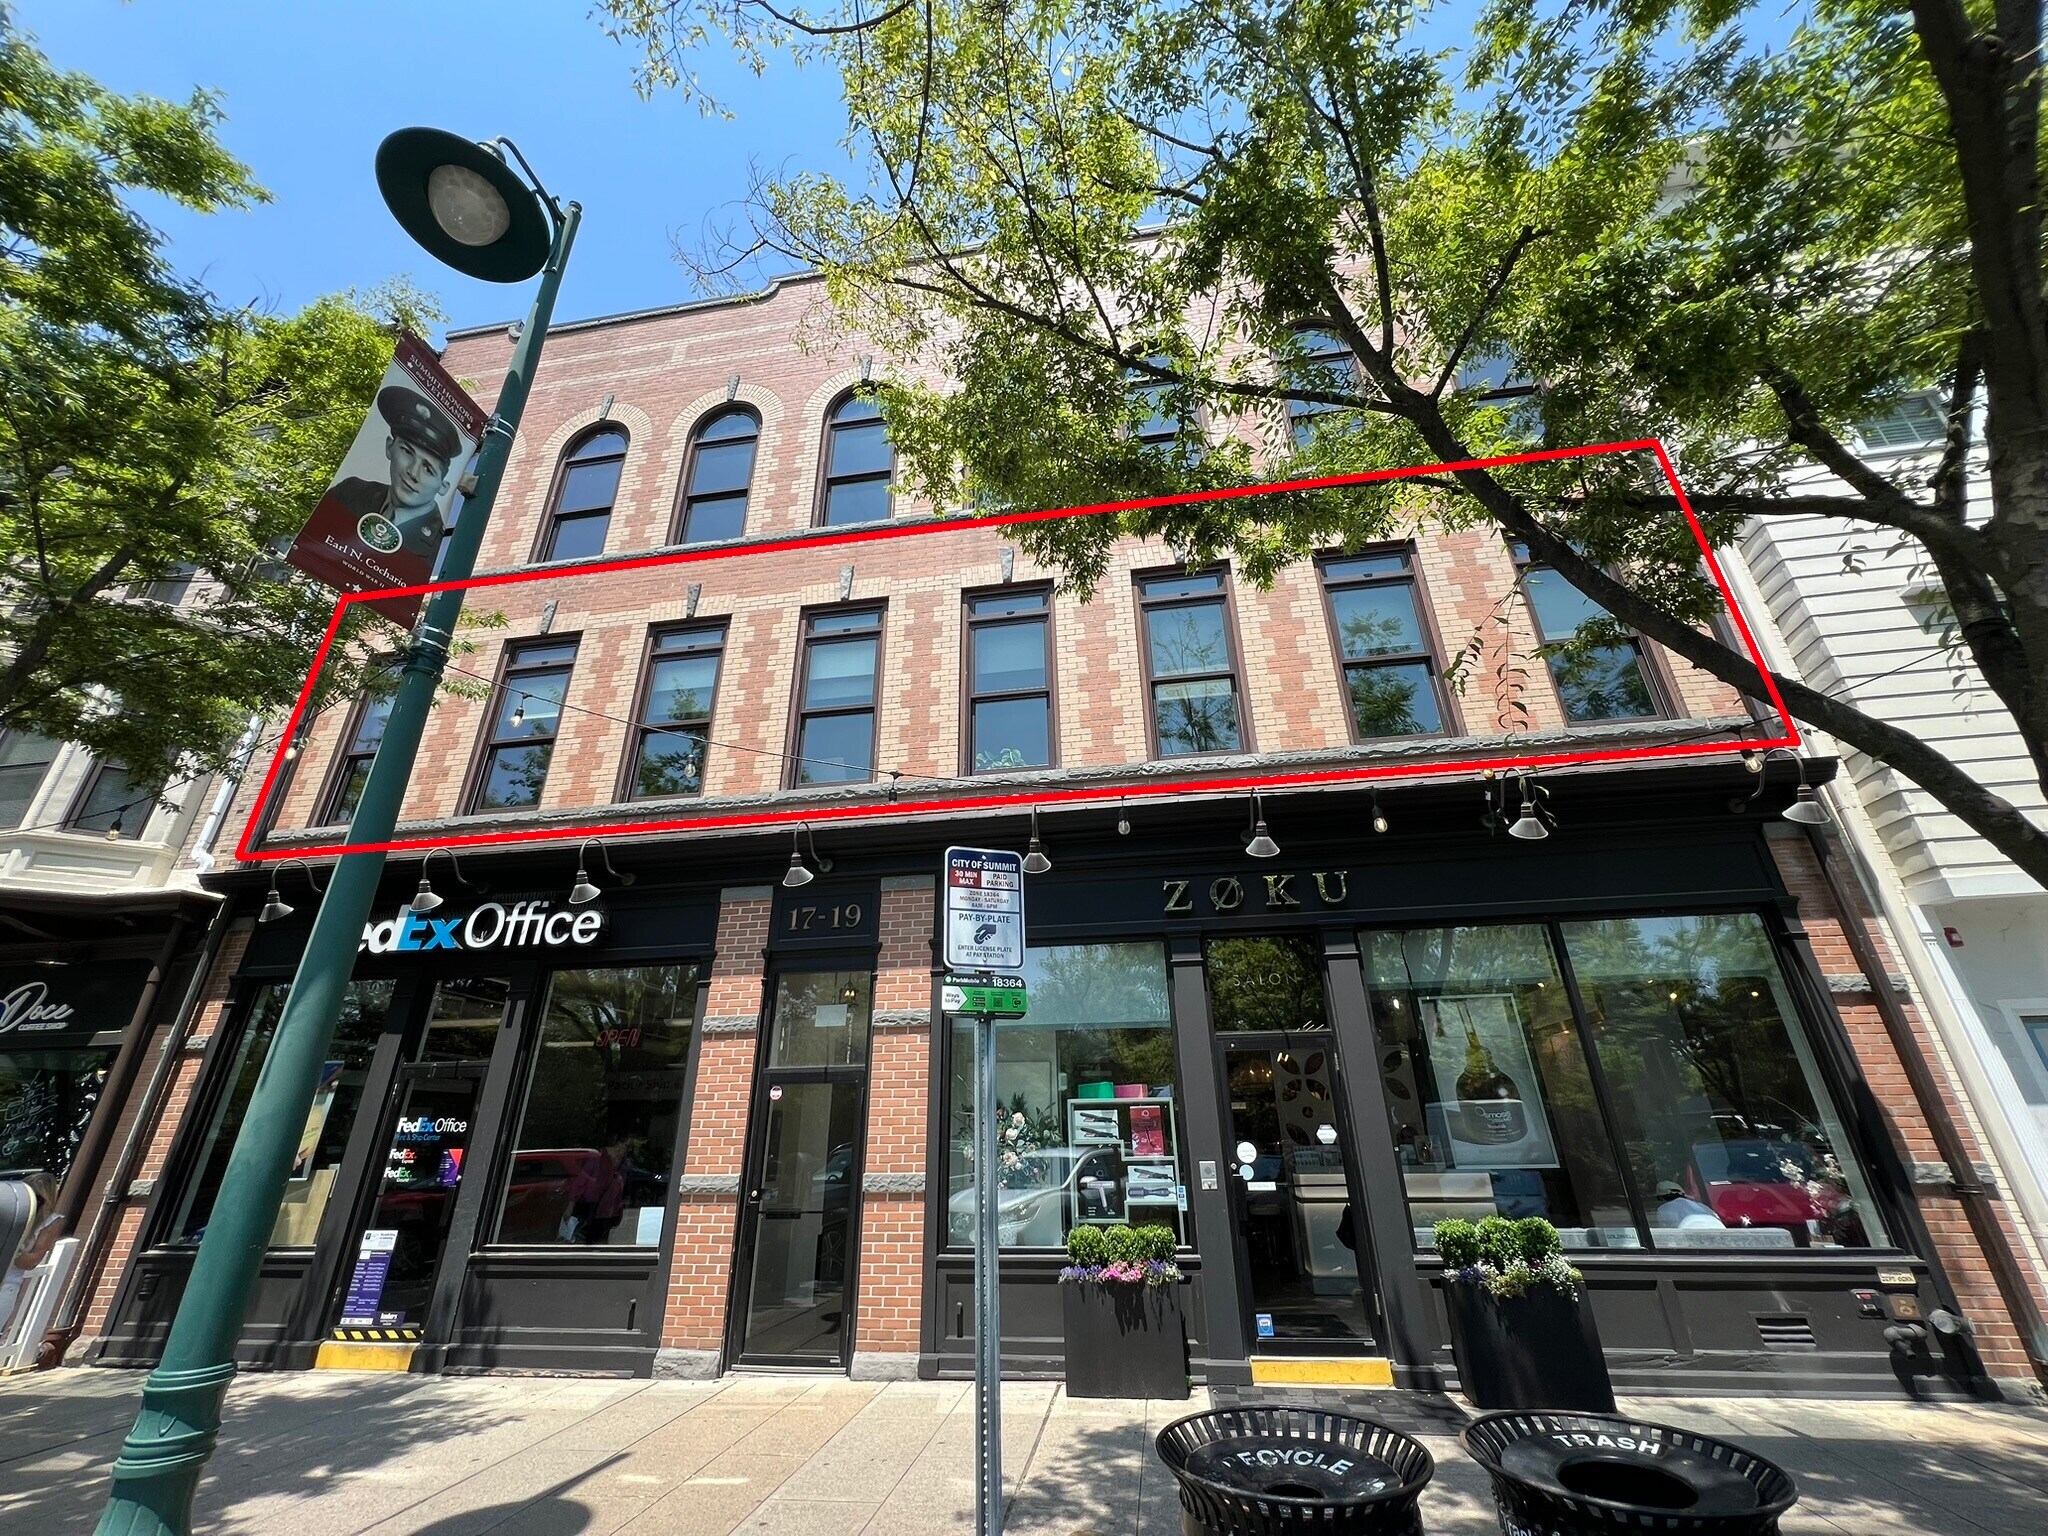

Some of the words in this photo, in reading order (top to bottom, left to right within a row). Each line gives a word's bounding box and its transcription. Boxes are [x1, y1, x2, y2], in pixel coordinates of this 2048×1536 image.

[409, 354, 442, 389] SUMMIT
[442, 388, 474, 423] HONORS
[426, 380, 466, 423] VETERANS
[324, 534, 348, 553] Earl
[349, 548, 363, 562] N.
[365, 557, 407, 588] Cochario
[342, 560, 365, 576] WORLD
[365, 572, 379, 584] WAR
[951, 858, 970, 868] CITY
[971, 860, 982, 869] OF
[983, 861, 1017, 872] SUMMIT
[954, 869, 964, 877] 30
[964, 870, 978, 878] MIN
[958, 877, 974, 885] MAX
[992, 872, 1008, 880] PAID
[986, 879, 1014, 888] PARKING
[464, 900, 603, 949] Office
[787, 903, 862, 931] 17-19
[958, 912, 1011, 924] PAY-BY-PLATE
[992, 978, 1023, 988] 18364
[1232, 972, 1298, 988] SALON
[18, 1022, 46, 1031] COFFEE
[45, 1021, 69, 1030] SHOP
[596, 1027, 642, 1048] OPEN
[396, 1116, 436, 1133] FedEx
[434, 1117, 467, 1133] Office
[389, 1148, 415, 1160] FedEx
[383, 1166, 411, 1179] FedEx
[1551, 1433, 1661, 1455] TRASH
